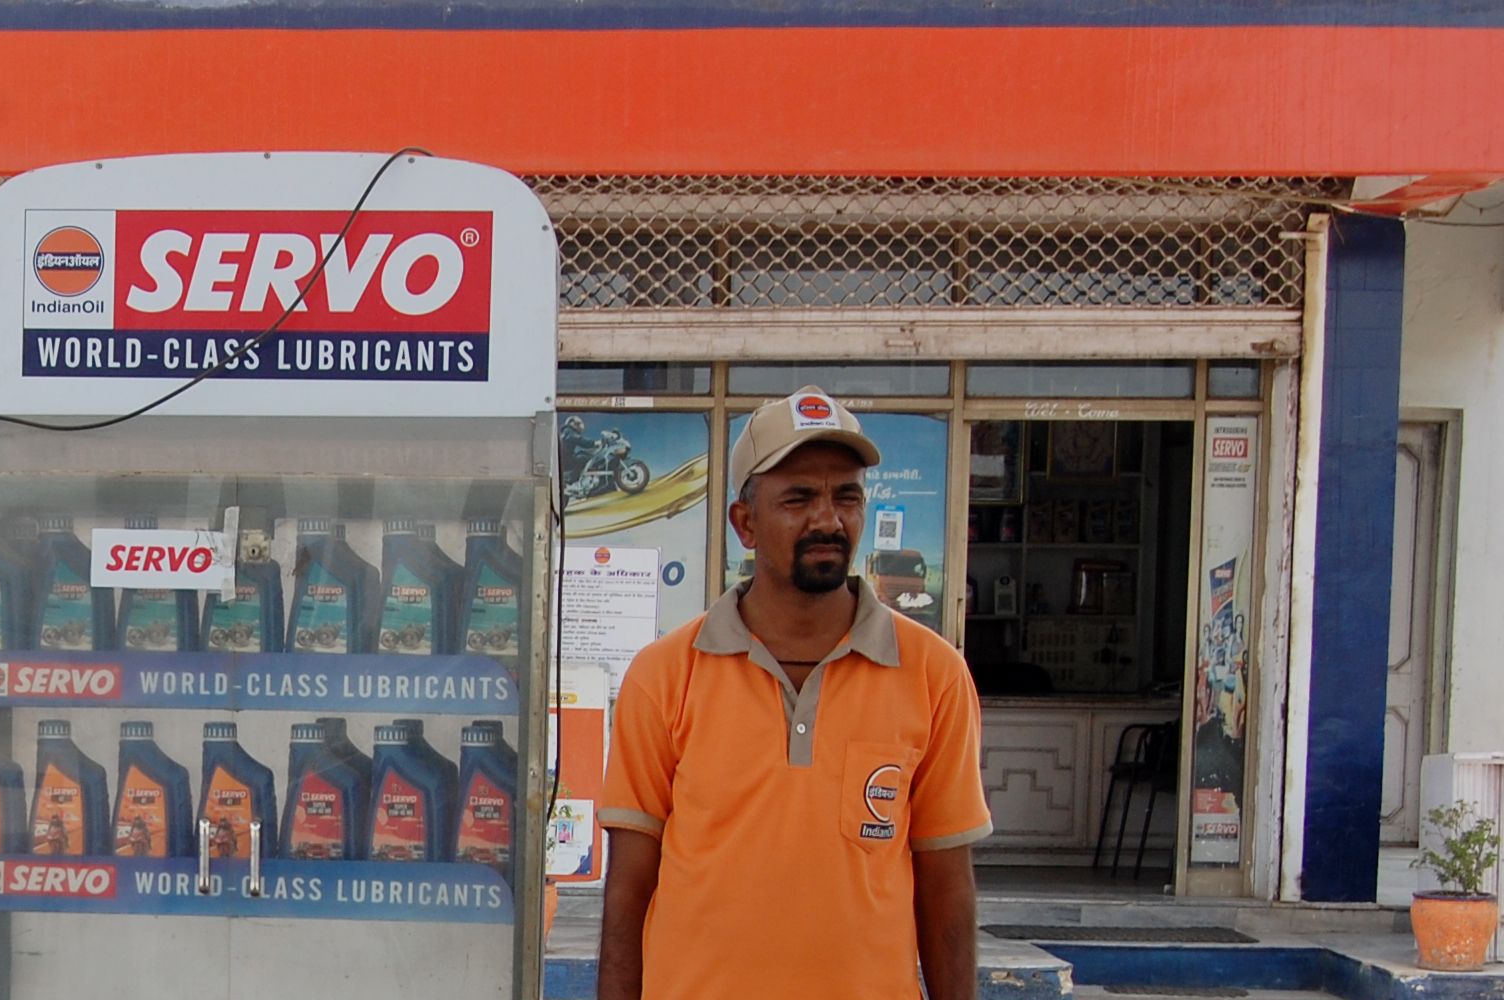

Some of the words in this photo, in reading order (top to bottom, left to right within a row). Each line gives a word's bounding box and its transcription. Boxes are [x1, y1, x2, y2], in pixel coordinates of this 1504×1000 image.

[31, 300, 104, 313] IndianOil
[37, 336, 261, 371] WORLD-CLASS
[277, 338, 474, 372] LUBRICANTS
[1213, 440, 1245, 456] SERVO
[106, 543, 213, 574] SERVO
[14, 667, 115, 694] SERVO
[140, 670, 328, 697] WORLD-CLASS
[343, 674, 509, 700] LUBRICANTS
[10, 865, 110, 894] SERVO
[337, 878, 501, 908] LUBRICANTS
